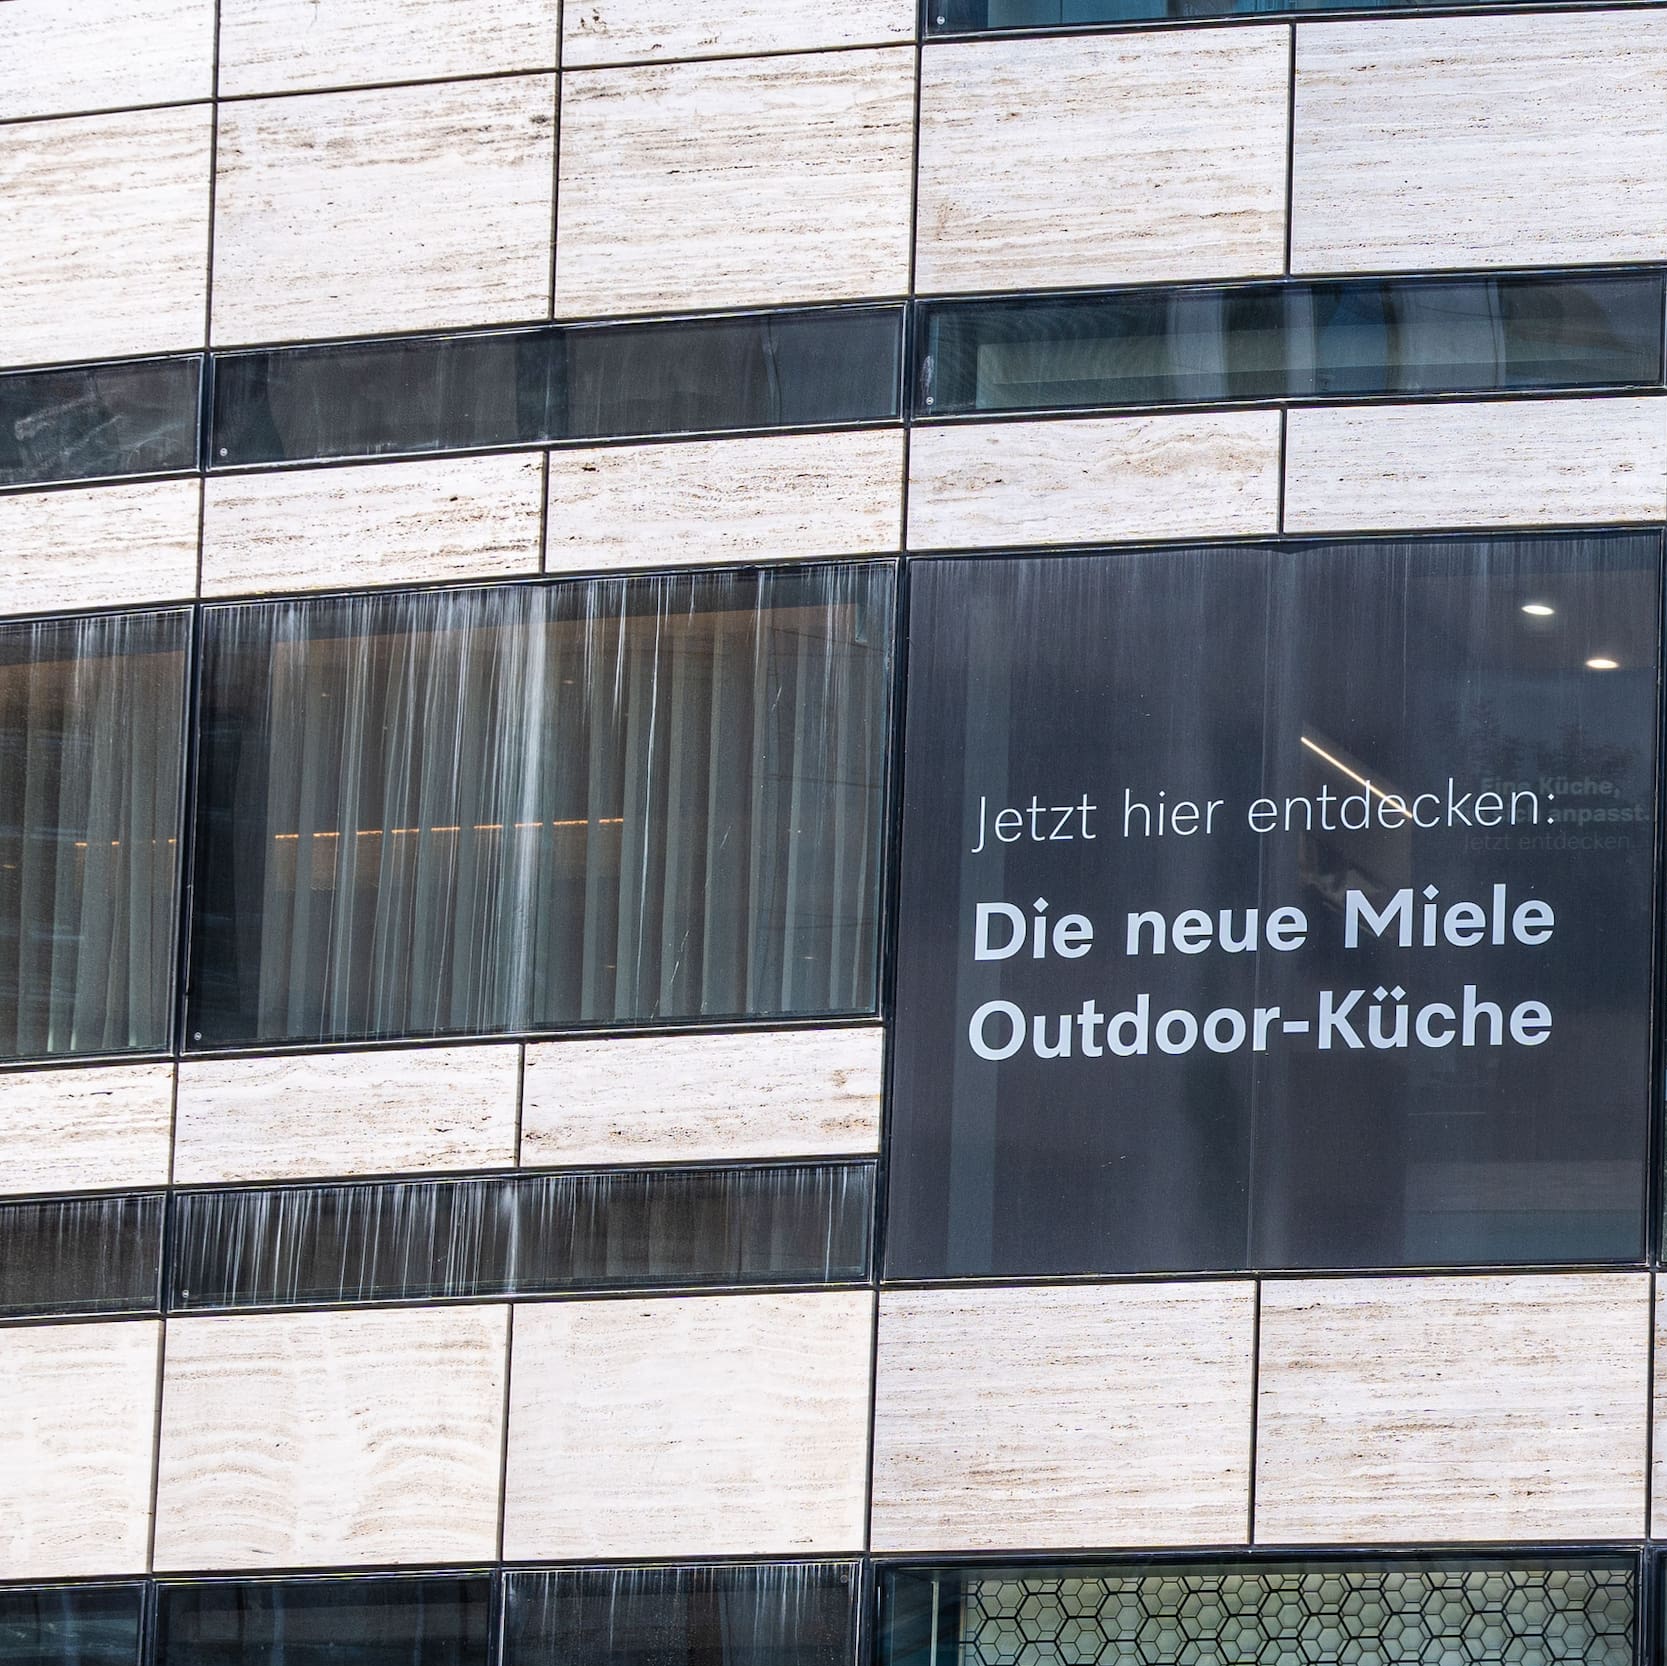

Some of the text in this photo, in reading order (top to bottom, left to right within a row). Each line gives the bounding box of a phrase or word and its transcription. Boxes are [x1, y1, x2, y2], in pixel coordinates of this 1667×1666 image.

[971, 776, 1555, 853] Jetzt hier entdecken:
[974, 883, 1555, 961] Die neue Miele
[968, 984, 1553, 1061] Outdoor-Küche
